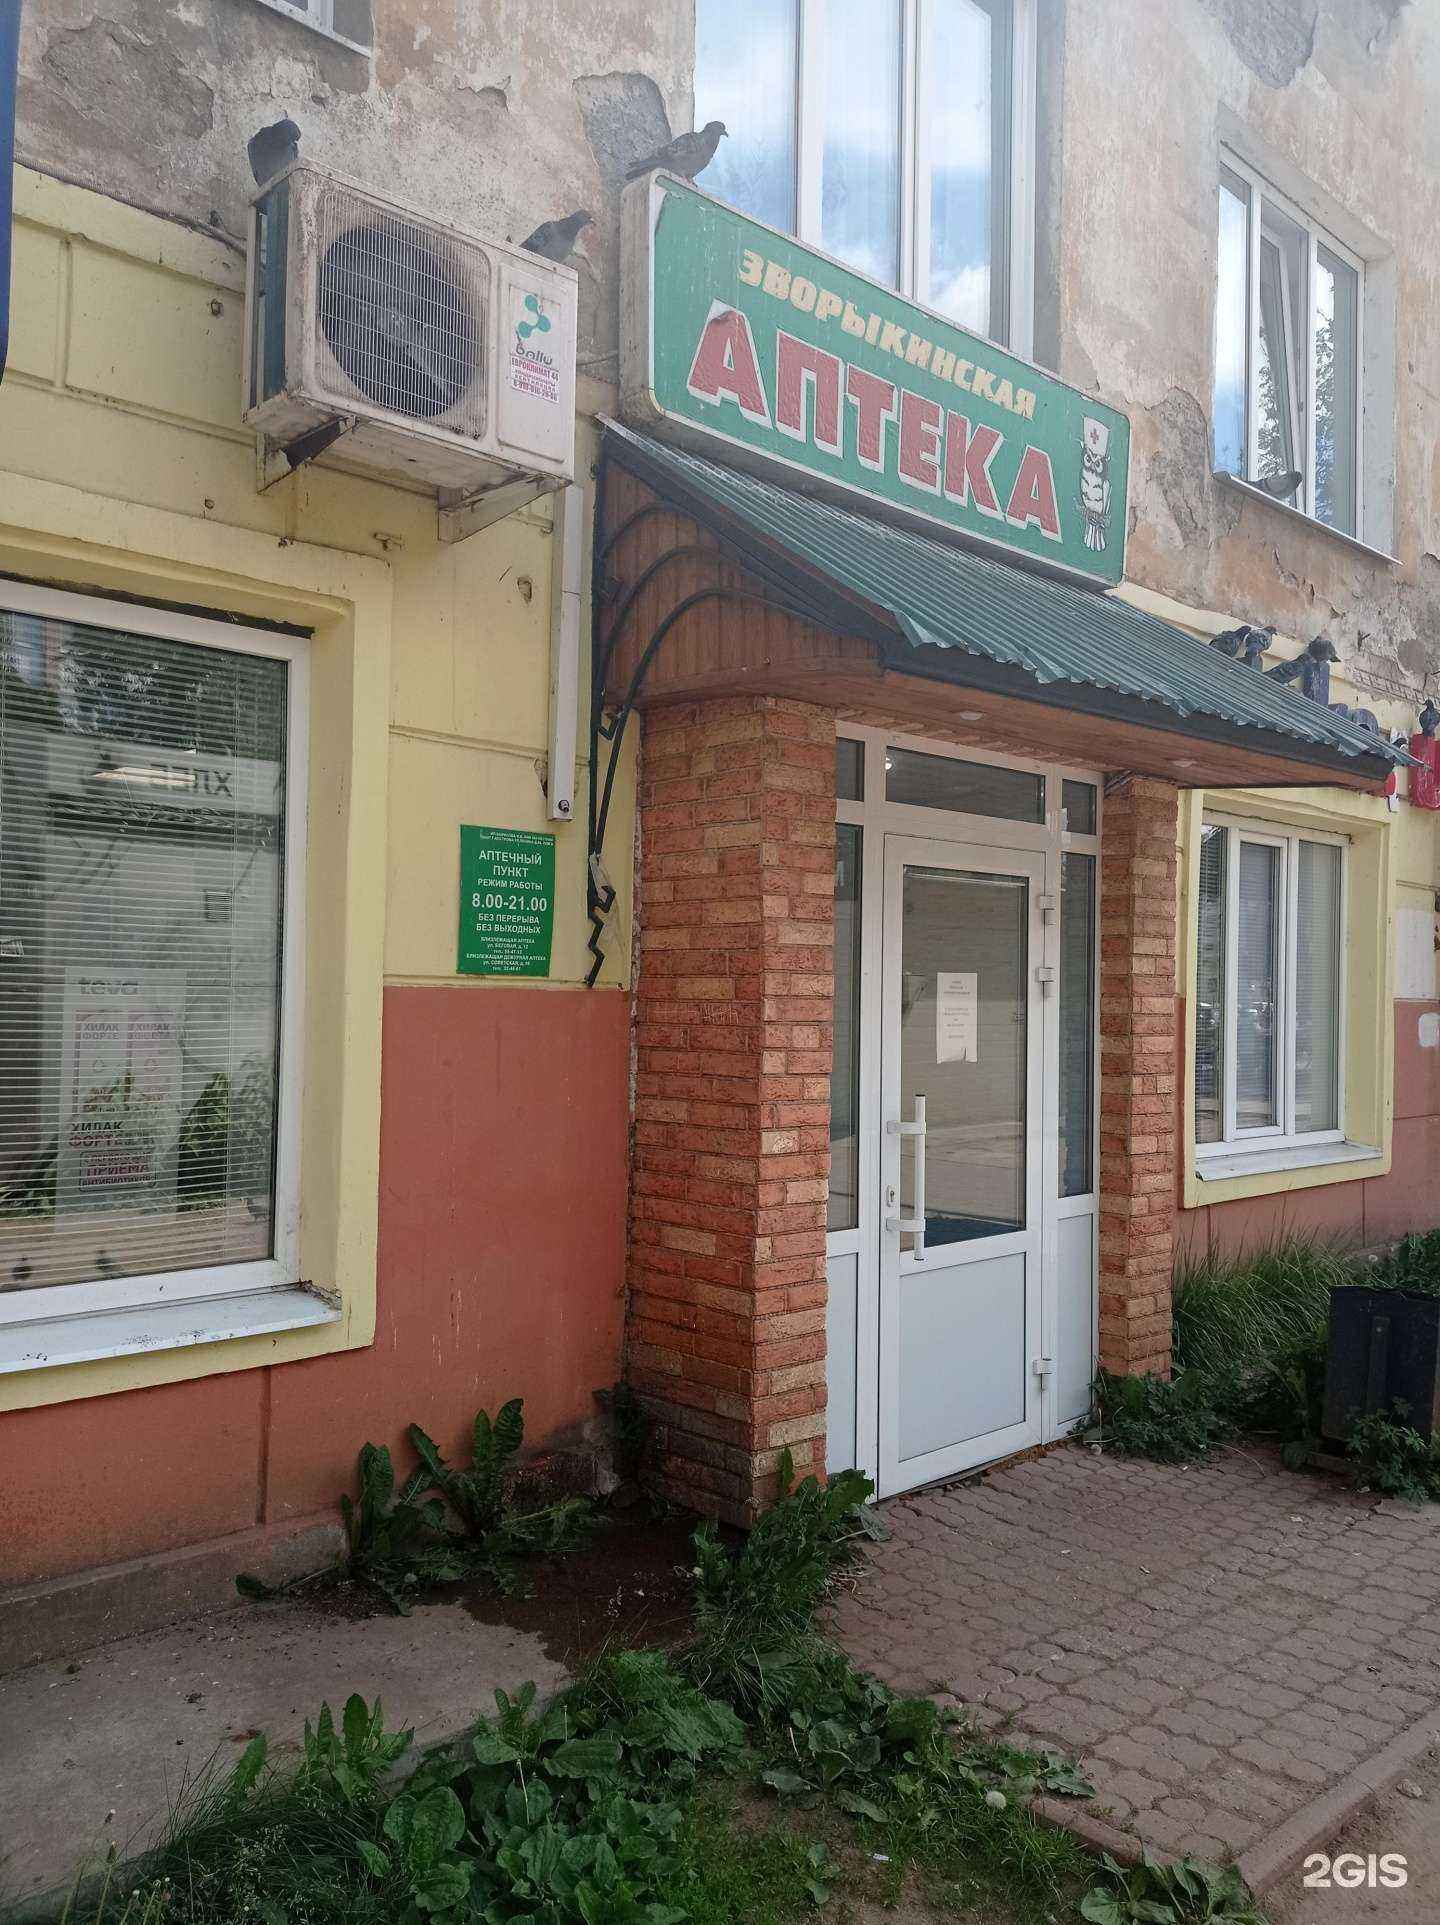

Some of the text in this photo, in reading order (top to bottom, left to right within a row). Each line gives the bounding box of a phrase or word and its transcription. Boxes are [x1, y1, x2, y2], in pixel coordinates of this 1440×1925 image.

[737, 248, 1038, 420] ЗВОРЫКИНСКАЯ
[686, 299, 1063, 544] АПТЕКА
[478, 850, 542, 865] АПТЕЧНЫЙ
[493, 865, 529, 878] ПУНКТ
[477, 878, 543, 890] РЕЖИМ РАБОТЫ
[472, 893, 547, 911] 8.00-21.00
[478, 913, 540, 924] БЕЗ ПЕРЕРЫВА
[476, 923, 541, 934] БЕЗ ВЫХОДНЫХ
